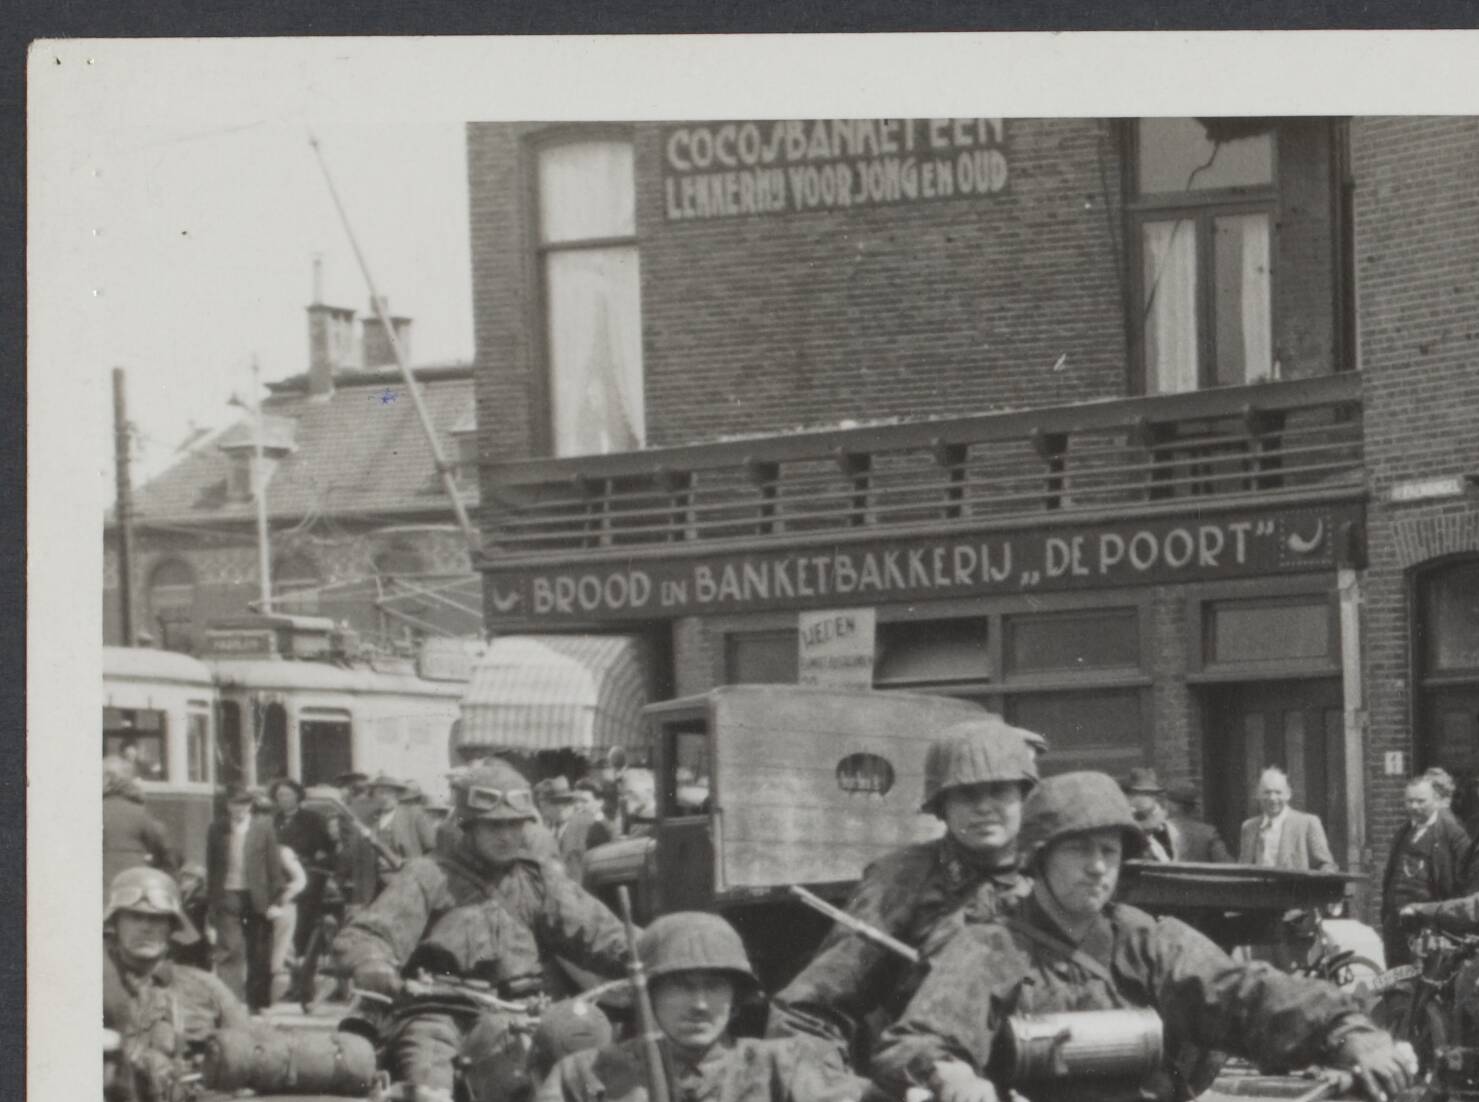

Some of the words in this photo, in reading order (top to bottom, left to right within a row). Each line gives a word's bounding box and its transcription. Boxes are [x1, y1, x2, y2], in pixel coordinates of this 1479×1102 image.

[788, 162, 851, 211] VOOR
[853, 156, 919, 204] JONG
[956, 150, 1008, 194] OUD
[533, 570, 651, 614] BROOD
[694, 541, 1011, 603] BANKETBAKKERIJ
